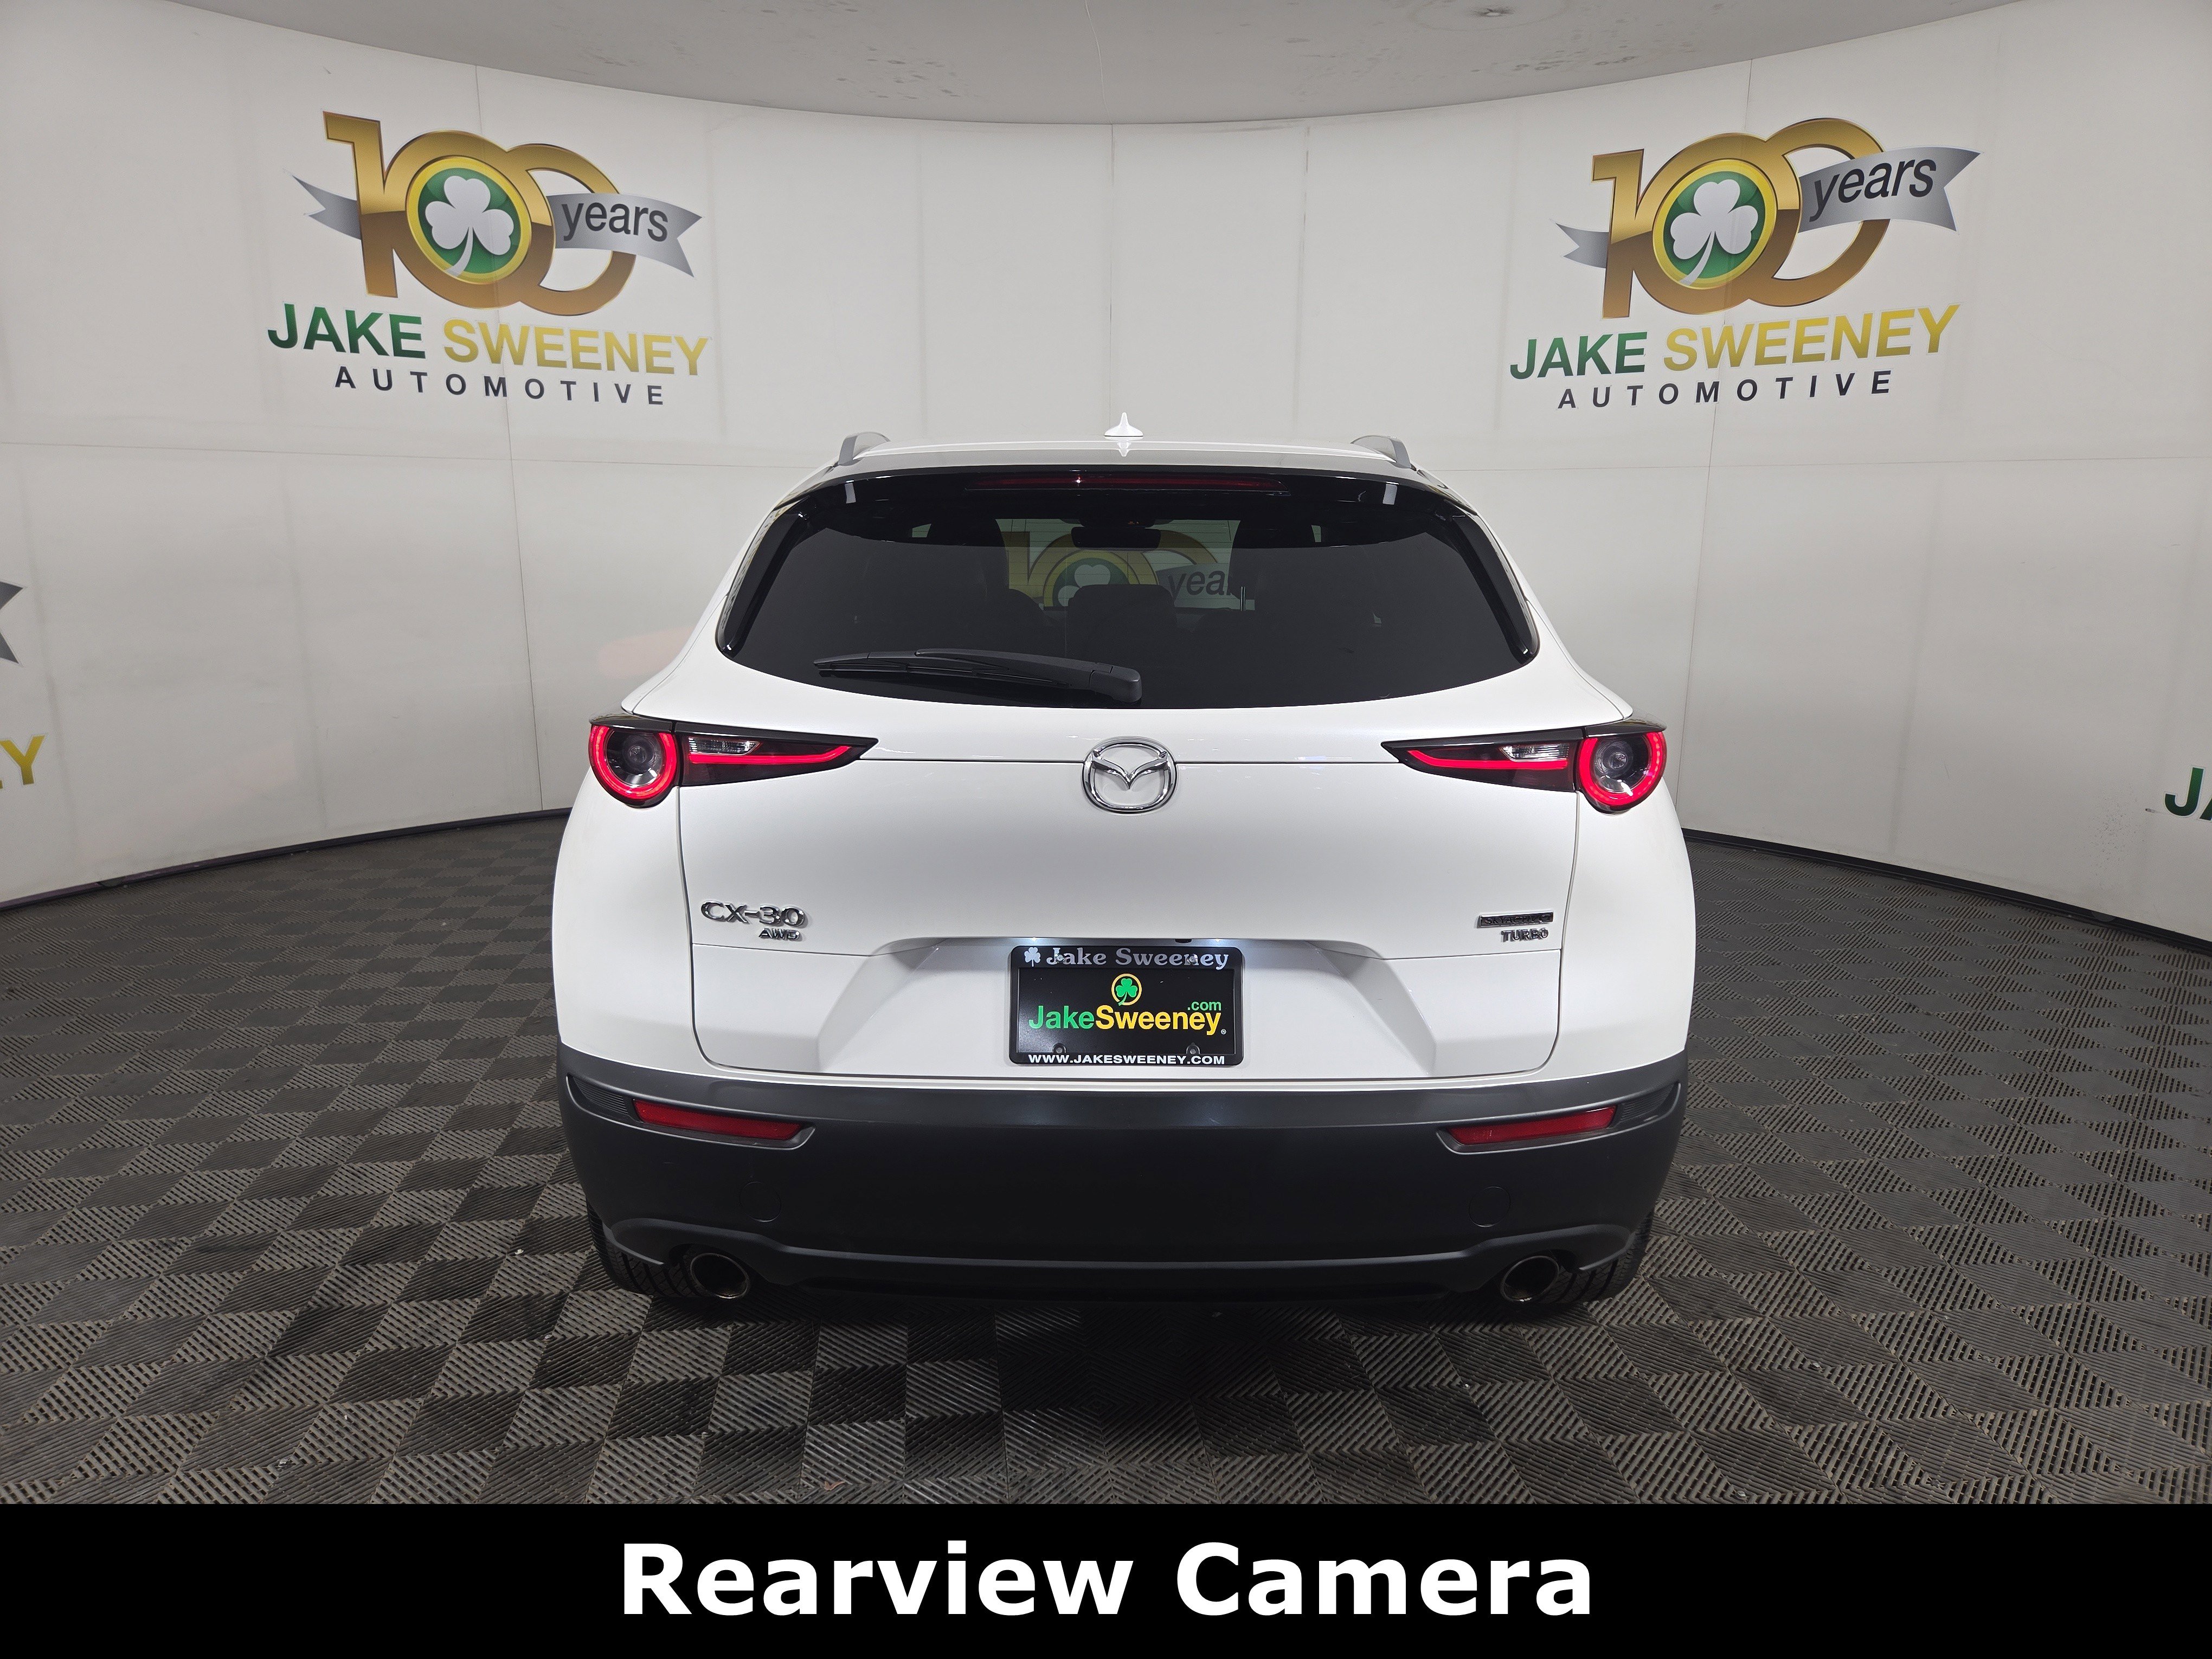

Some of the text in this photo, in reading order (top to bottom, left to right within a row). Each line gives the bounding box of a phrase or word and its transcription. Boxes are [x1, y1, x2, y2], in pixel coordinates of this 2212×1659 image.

[1809, 157, 1937, 223] years
[562, 202, 668, 242] years
[267, 303, 710, 375] JAKE SWEENEY
[1510, 305, 1961, 380] JAKE SWEENEY
[335, 366, 664, 405] AUTOMOTIVE
[1558, 370, 1892, 410] AUTOMOTIVE
[701, 901, 806, 927] CX-30
[758, 928, 802, 941] AWD
[1501, 928, 1549, 942] TURBO
[1046, 947, 1229, 969] Jake Sweeney
[1028, 1054, 1225, 1065] WWW.JAKESWEENEY.COM
